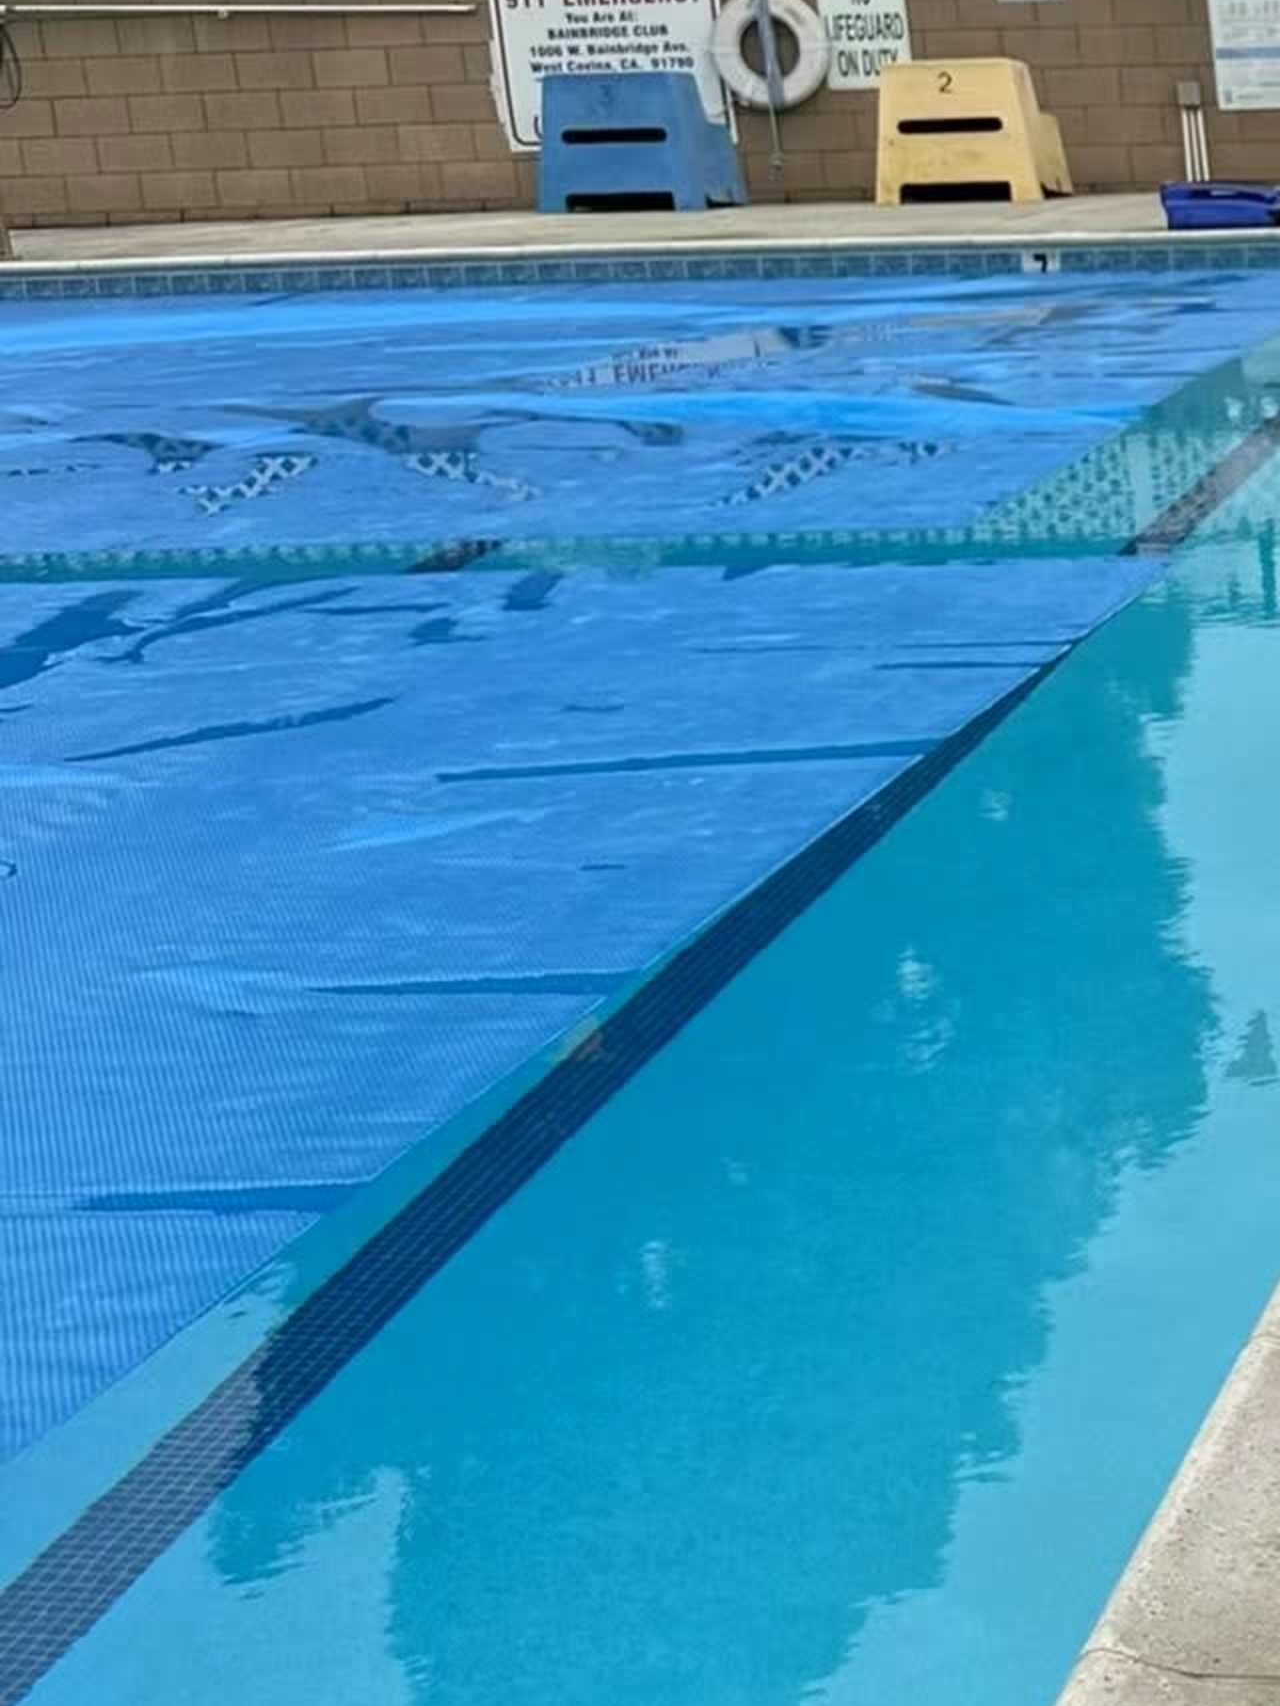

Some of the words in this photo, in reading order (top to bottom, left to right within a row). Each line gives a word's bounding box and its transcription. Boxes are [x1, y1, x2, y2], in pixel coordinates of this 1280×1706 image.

[566, 12, 588, 24] You
[824, 11, 905, 41] LIFEGUARD
[547, 26, 628, 40] BAINBRIDGE
[633, 24, 668, 37] CLUB
[838, 50, 860, 77] ON
[938, 70, 953, 94] 2
